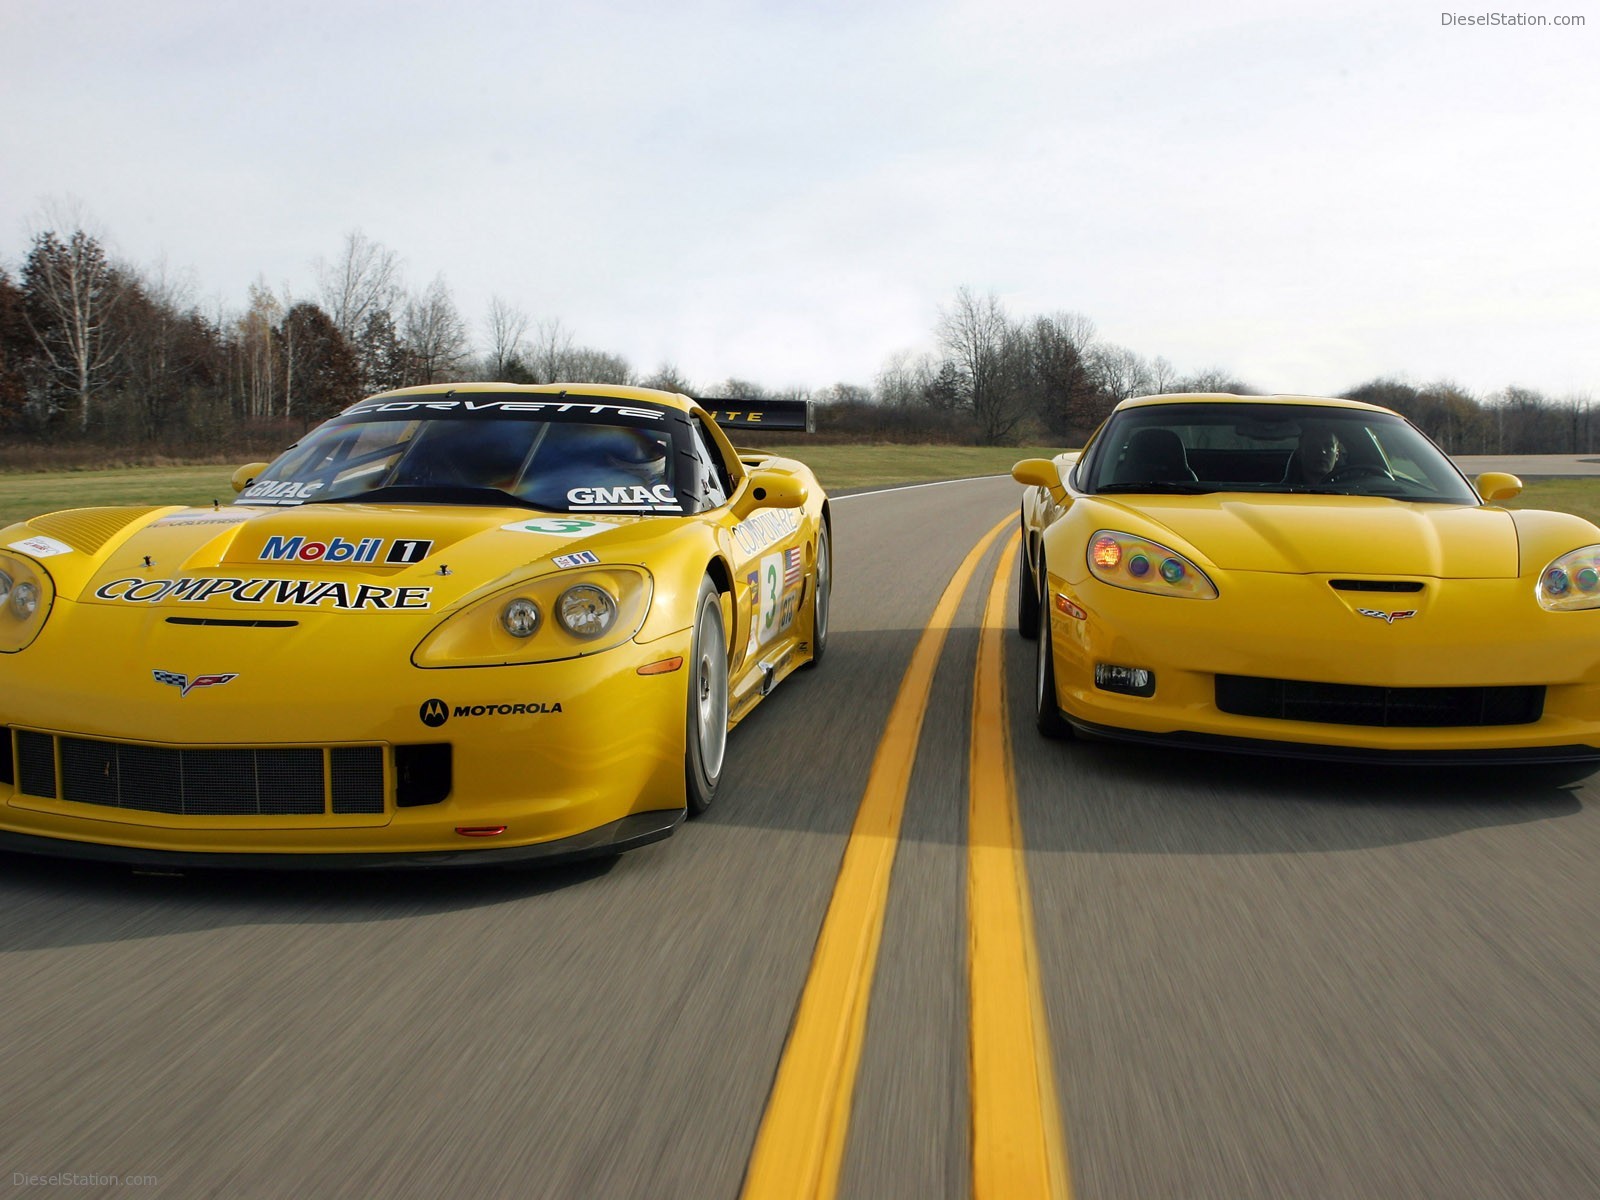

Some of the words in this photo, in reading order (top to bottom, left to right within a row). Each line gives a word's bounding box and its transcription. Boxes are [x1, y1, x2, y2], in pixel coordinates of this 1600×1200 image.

[342, 401, 665, 420] CORVETTE
[244, 480, 324, 499] GMAC
[566, 484, 678, 504] GMAC
[524, 520, 597, 533] 3
[258, 535, 384, 563] Mobil
[95, 577, 433, 610] COMPUWARE
[765, 564, 777, 629] 3
[453, 703, 563, 718] MOTOROLA
